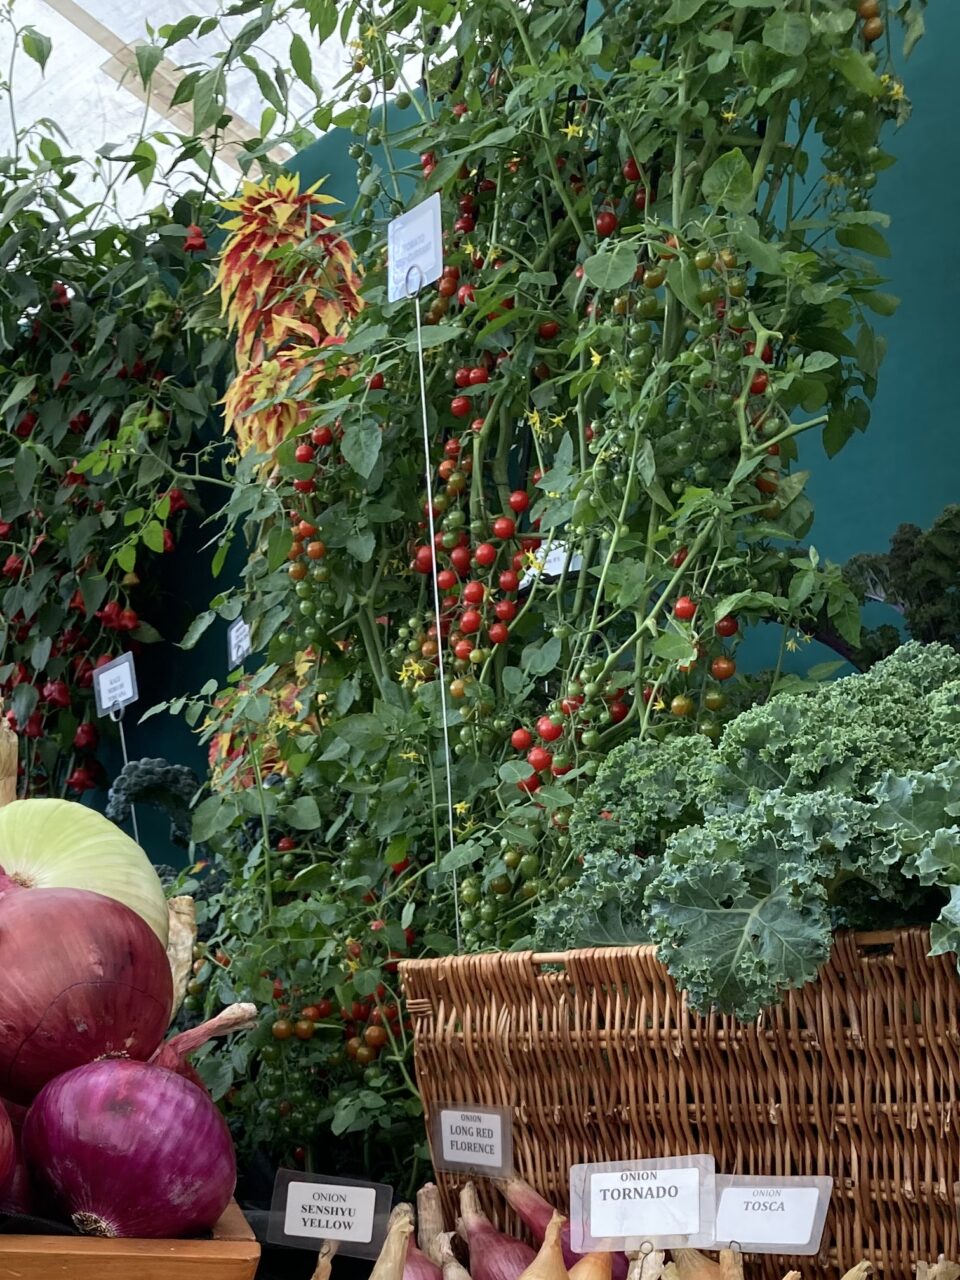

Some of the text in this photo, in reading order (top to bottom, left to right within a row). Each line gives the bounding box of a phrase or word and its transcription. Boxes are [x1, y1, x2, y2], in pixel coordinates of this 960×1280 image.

[461, 1114, 482, 1123] ONION
[450, 1125, 494, 1139] LONG RED
[450, 1140, 495, 1155] FLORENCE
[620, 1171, 658, 1181] ONION
[312, 1192, 347, 1203] ONION
[600, 1185, 679, 1201] TORNADO
[752, 1189, 782, 1197] ONION
[301, 1204, 356, 1217] SENSHYU
[743, 1201, 785, 1212] TOSCA
[302, 1217, 355, 1230] YELLOW
